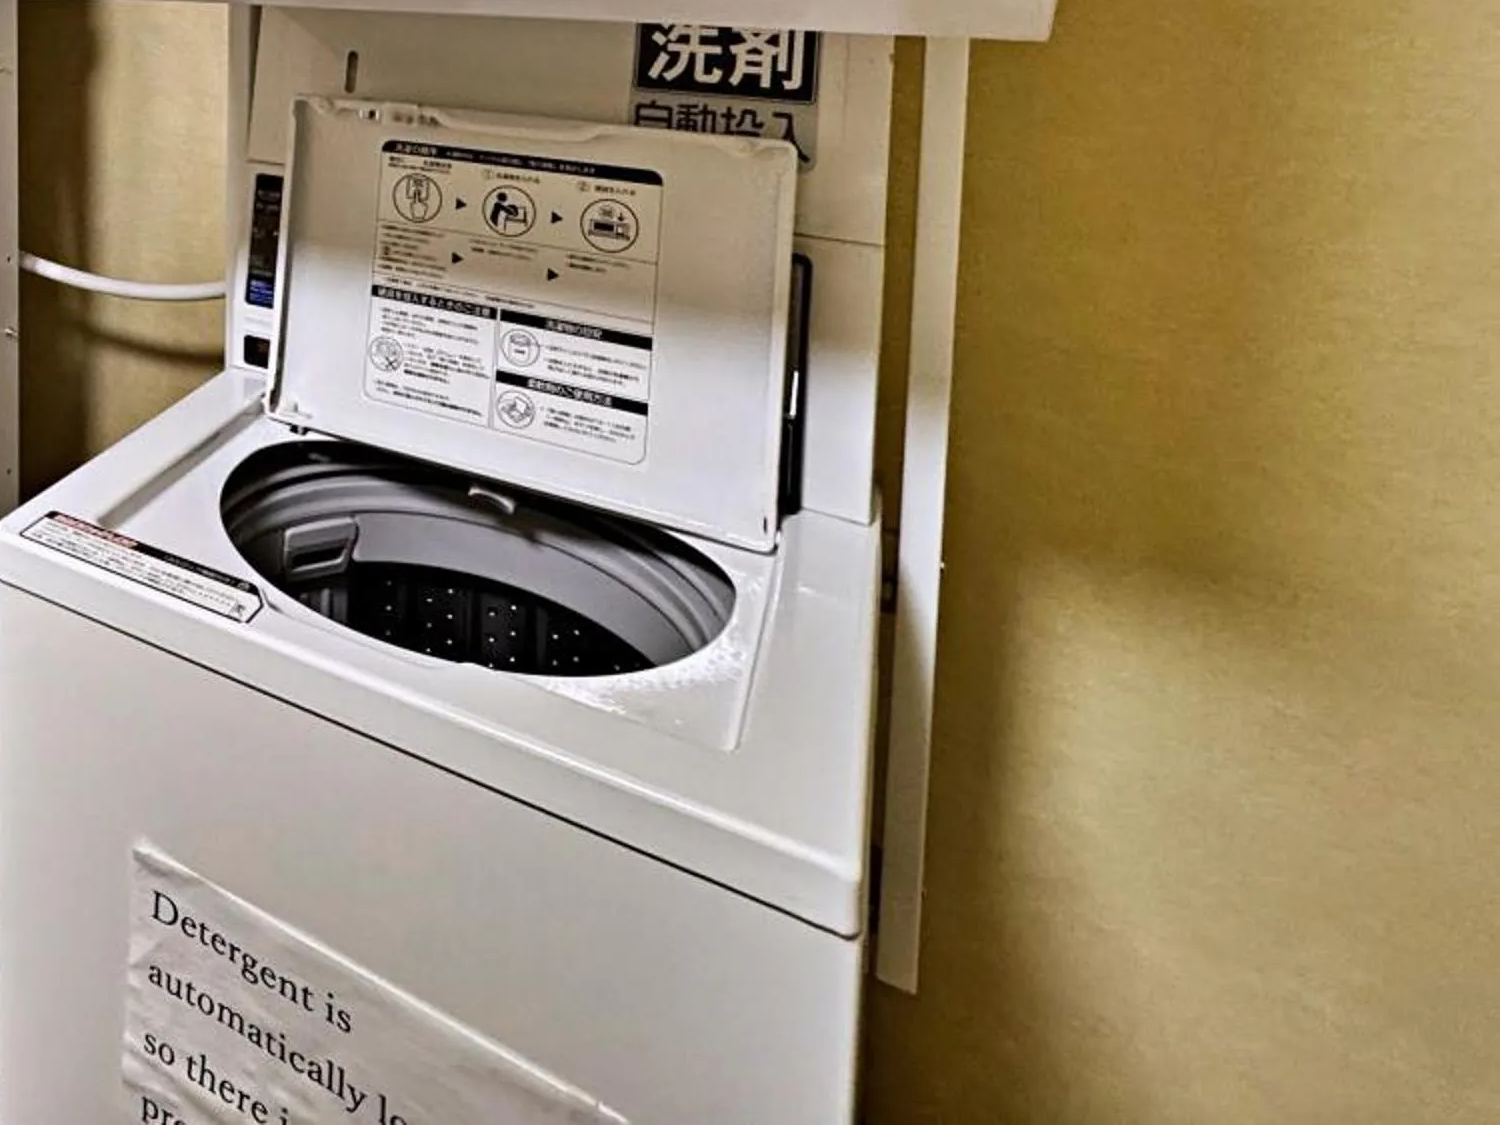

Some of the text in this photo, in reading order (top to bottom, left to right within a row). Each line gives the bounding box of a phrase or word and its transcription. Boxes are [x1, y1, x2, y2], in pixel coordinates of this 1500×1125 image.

[648, 23, 805, 91] 洗剤
[151, 890, 353, 1034] Detergent is
[143, 1032, 175, 1066] so
[186, 1053, 269, 1124] there
[148, 962, 368, 1114] automatically
